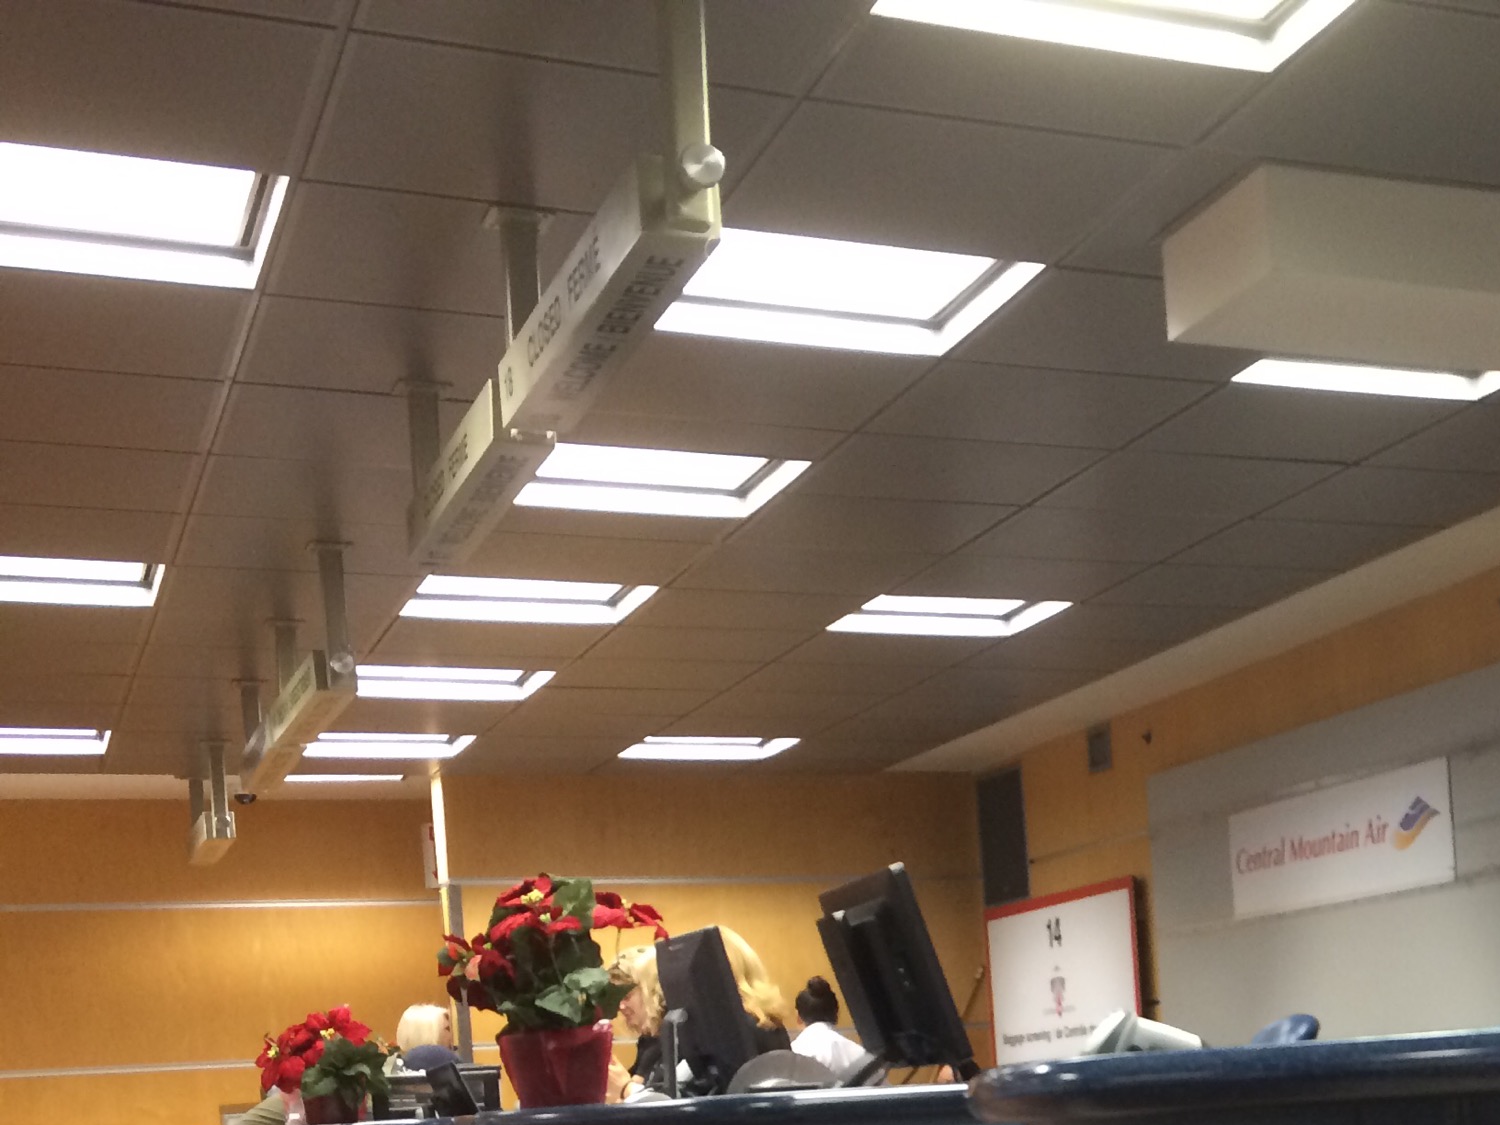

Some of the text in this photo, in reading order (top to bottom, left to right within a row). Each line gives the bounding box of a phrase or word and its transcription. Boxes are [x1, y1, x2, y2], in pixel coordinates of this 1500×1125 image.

[1235, 814, 1389, 875] Central Mountain Air
[1046, 917, 1063, 948] 14
